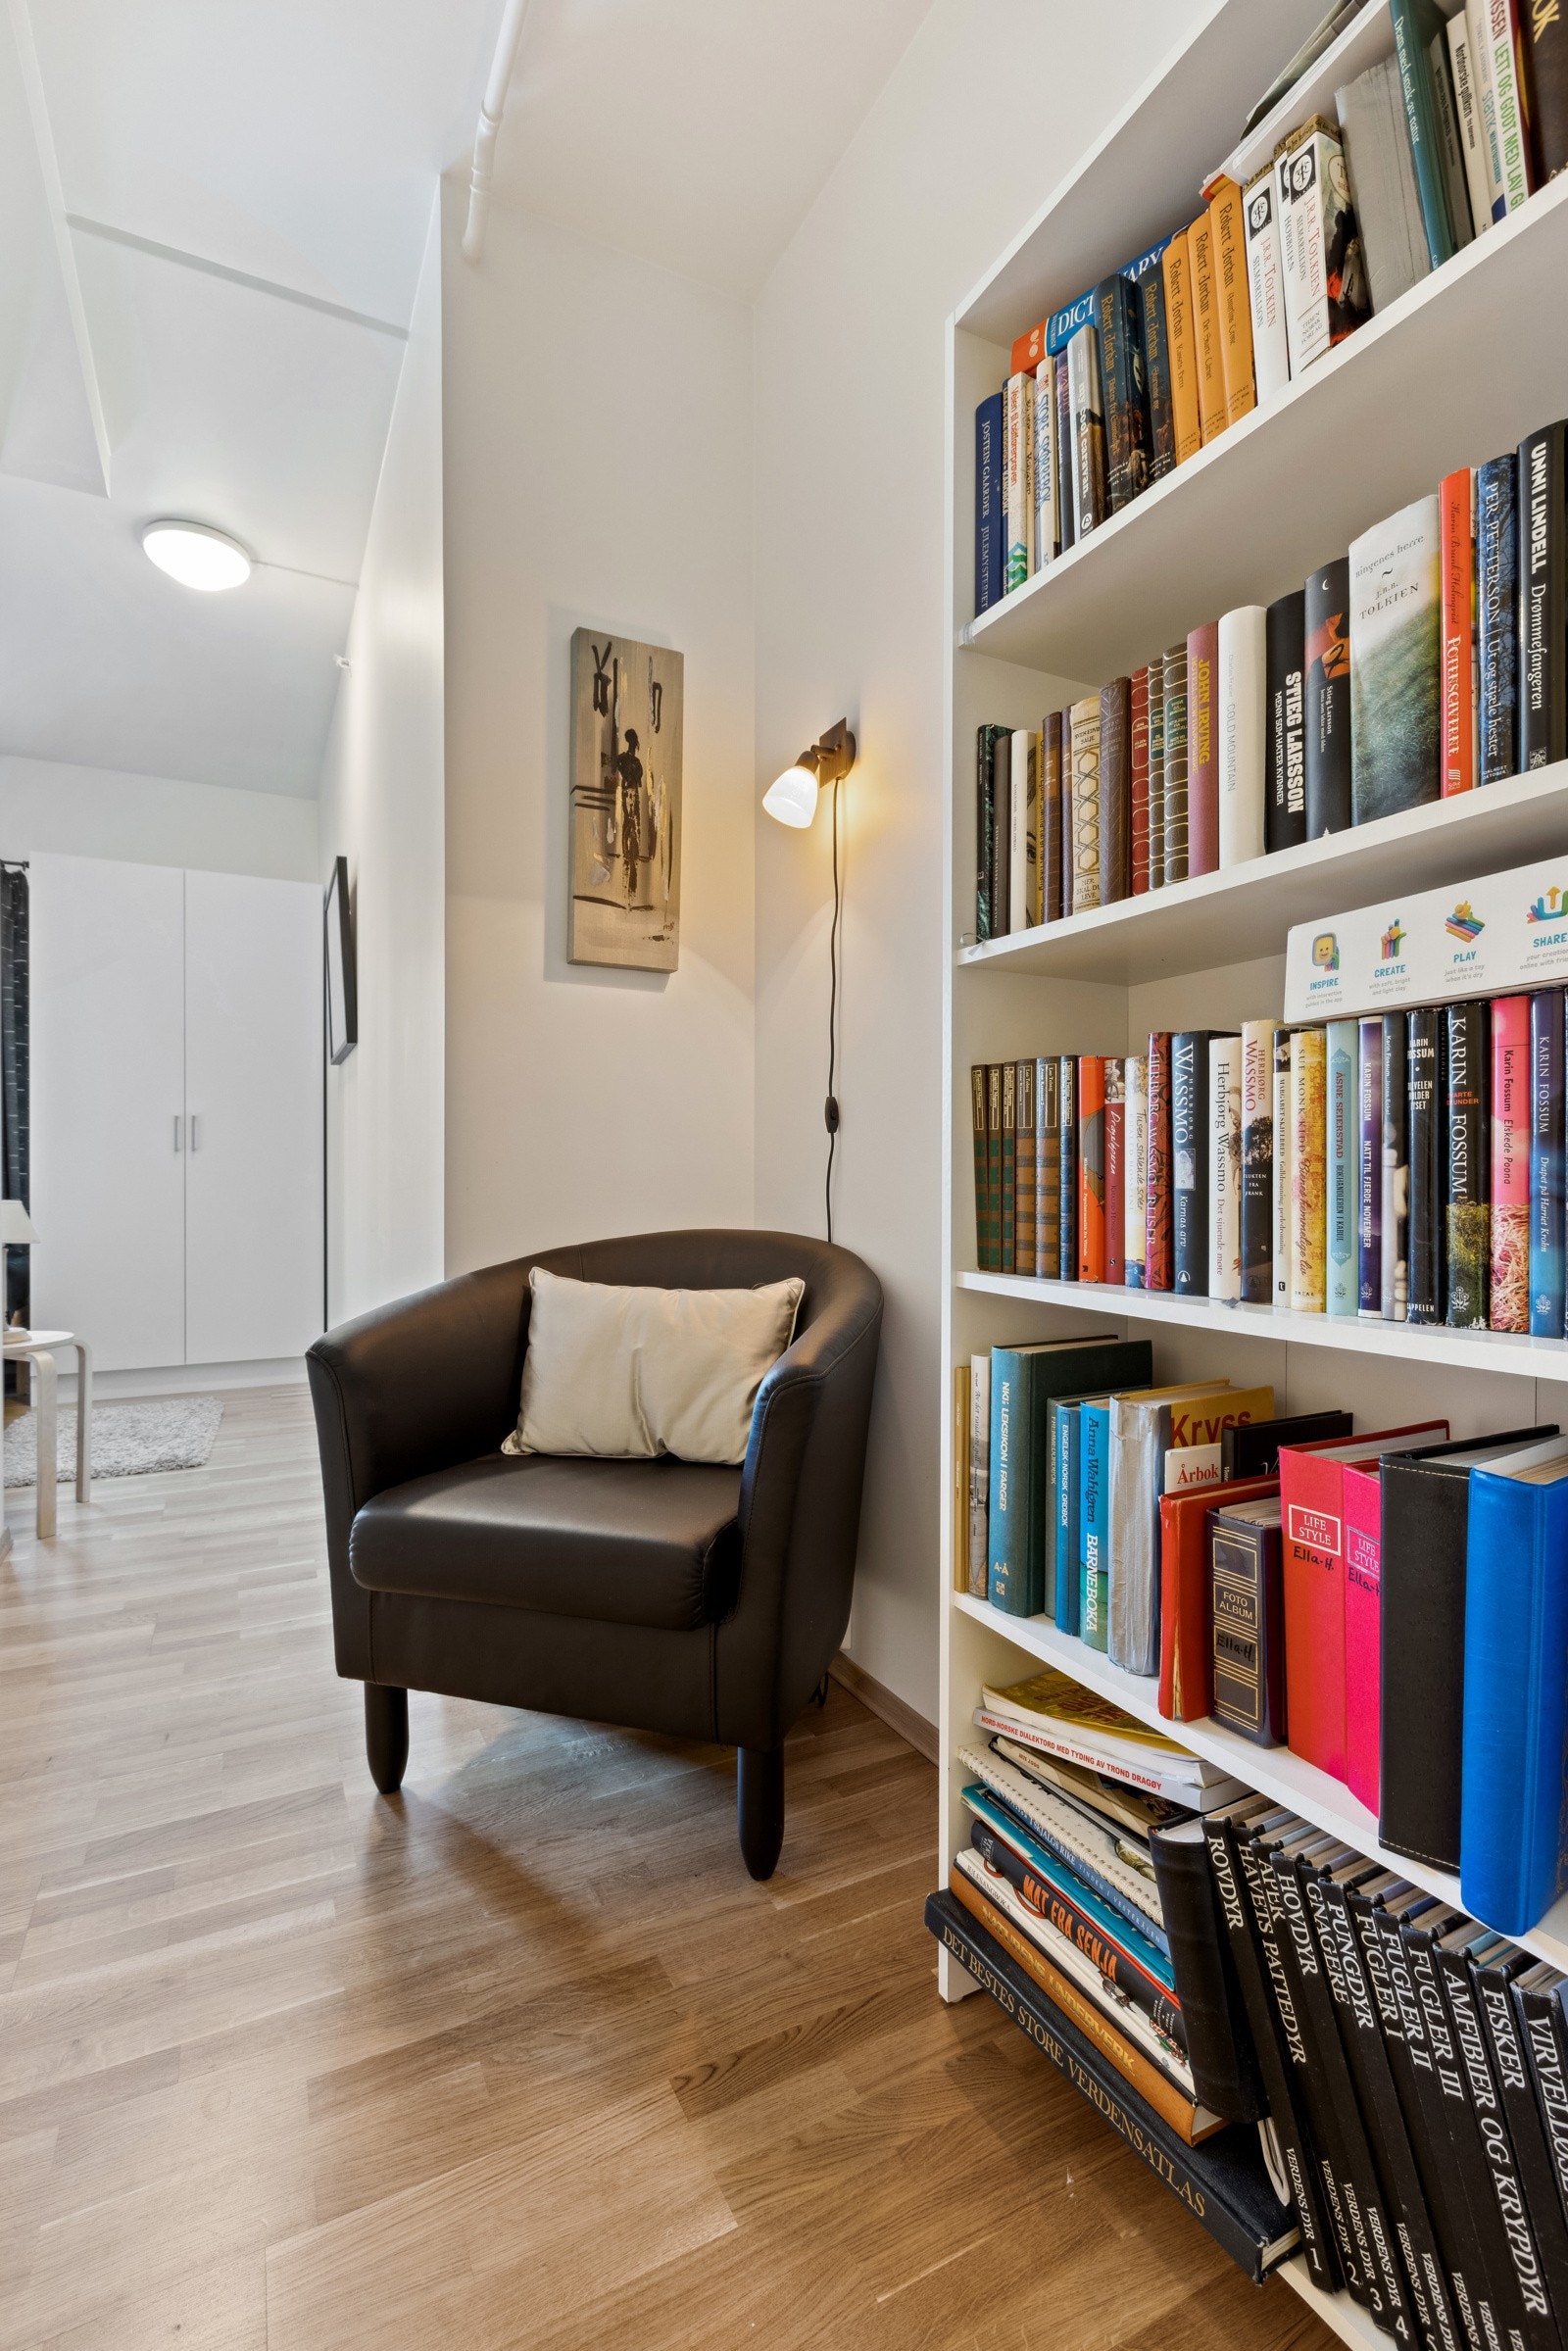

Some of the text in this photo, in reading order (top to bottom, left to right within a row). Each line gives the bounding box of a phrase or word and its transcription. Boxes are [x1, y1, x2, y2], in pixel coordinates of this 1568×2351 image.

[1394, 16, 1420, 145] Dram med smak av natur
[1454, 43, 1470, 86] Nordnorske
[1457, 86, 1473, 118] gullkorn
[1218, 203, 1232, 244] Robert
[1297, 215, 1306, 281] SILMARILLION
[1170, 261, 1184, 340] Robert Jordan
[1222, 246, 1236, 288] Jordan
[1252, 256, 1264, 328] SILMARILLION
[1101, 294, 1116, 371] Robert Jordan
[1145, 282, 1159, 360] Robert Jordan
[981, 419, 991, 465] JOSTEIN
[1358, 583, 1419, 619] TOLKIEN
[1530, 442, 1545, 710] UNNI LINDELL Drømmefangeren
[1485, 481, 1501, 758] PER PETTERSON Ut og stjæle hester
[1198, 659, 1210, 764] JOHN IRVING
[1286, 671, 1304, 813] STIEG LARSSON
[1374, 964, 1406, 978] CREATE
[1453, 951, 1476, 962] PLAY
[1533, 933, 1568, 948] SHARE
[1310, 978, 1339, 990] INSPIRE
[1175, 1042, 1194, 1144] WASSMO
[1215, 1062, 1229, 1129] Herbjørg
[1245, 1039, 1257, 1110] WASSMO
[1451, 1017, 1467, 1194] KARIN FOSSUM
[1503, 1050, 1513, 1185] Karin Fossum Elskede Poona
[1539, 1037, 1549, 1251] KARIN FOSSUM Drapet på Harriet Krohn
[1217, 1133, 1229, 1192] Wassmo
[1215, 1217, 1225, 1250] sjuende
[1177, 1464, 1218, 1485] Årbok
[1086, 1416, 1099, 1632] Anna Wahlgren BARNEBOKA
[1299, 1527, 1332, 1546] STYLE
[1304, 1515, 1326, 1531] LIFE
[1355, 1550, 1379, 1571] STYLE
[1358, 1538, 1376, 1556] LIFE
[1219, 1601, 1252, 1620] ALBUM
[1223, 1591, 1248, 1607] FOTO
[981, 1716, 1162, 1789] NORD-NORSKE DIALEKTORD MED TYDING AV TROND DRAGØY
[966, 1865, 1011, 1912] JULESANGBOKA
[1207, 1836, 1245, 1931] ROVDYR
[1023, 1875, 1118, 1982] MAT FRA SENJA
[1238, 1843, 1306, 2064] HAVETS PATTEDYR
[1277, 1872, 1318, 1976] HOVDYR
[1306, 1883, 1348, 2004] GNAGERE
[1327, 1901, 1374, 2029] PUNGDYR
[1382, 1929, 1433, 2072] FUGLER II
[1408, 1946, 1465, 2101] FUGLER III
[1482, 1986, 1526, 2089] FISKER
[943, 1927, 967, 1963] DET
[969, 1956, 1016, 2014] BESTES
[1017, 2007, 1064, 2069] STORE
[1069, 2056, 1206, 2217] VERDENSATLAS
[1444, 1968, 1548, 2316] AMFIBIER OG KRYPDYR
[1287, 2147, 1322, 2271] VERDENS DYR 1
[1322, 2160, 1359, 2284] VERDENS DYR 2
[1344, 2182, 1383, 2312] VERDENS DYR 3
[1367, 2207, 1408, 2340] VERDENS DYR 4
[1396, 2223, 1431, 2326] VERDENS DYR
[1422, 2253, 1448, 2328] VERDENS
[1451, 2273, 1480, 2345] VERDENS
